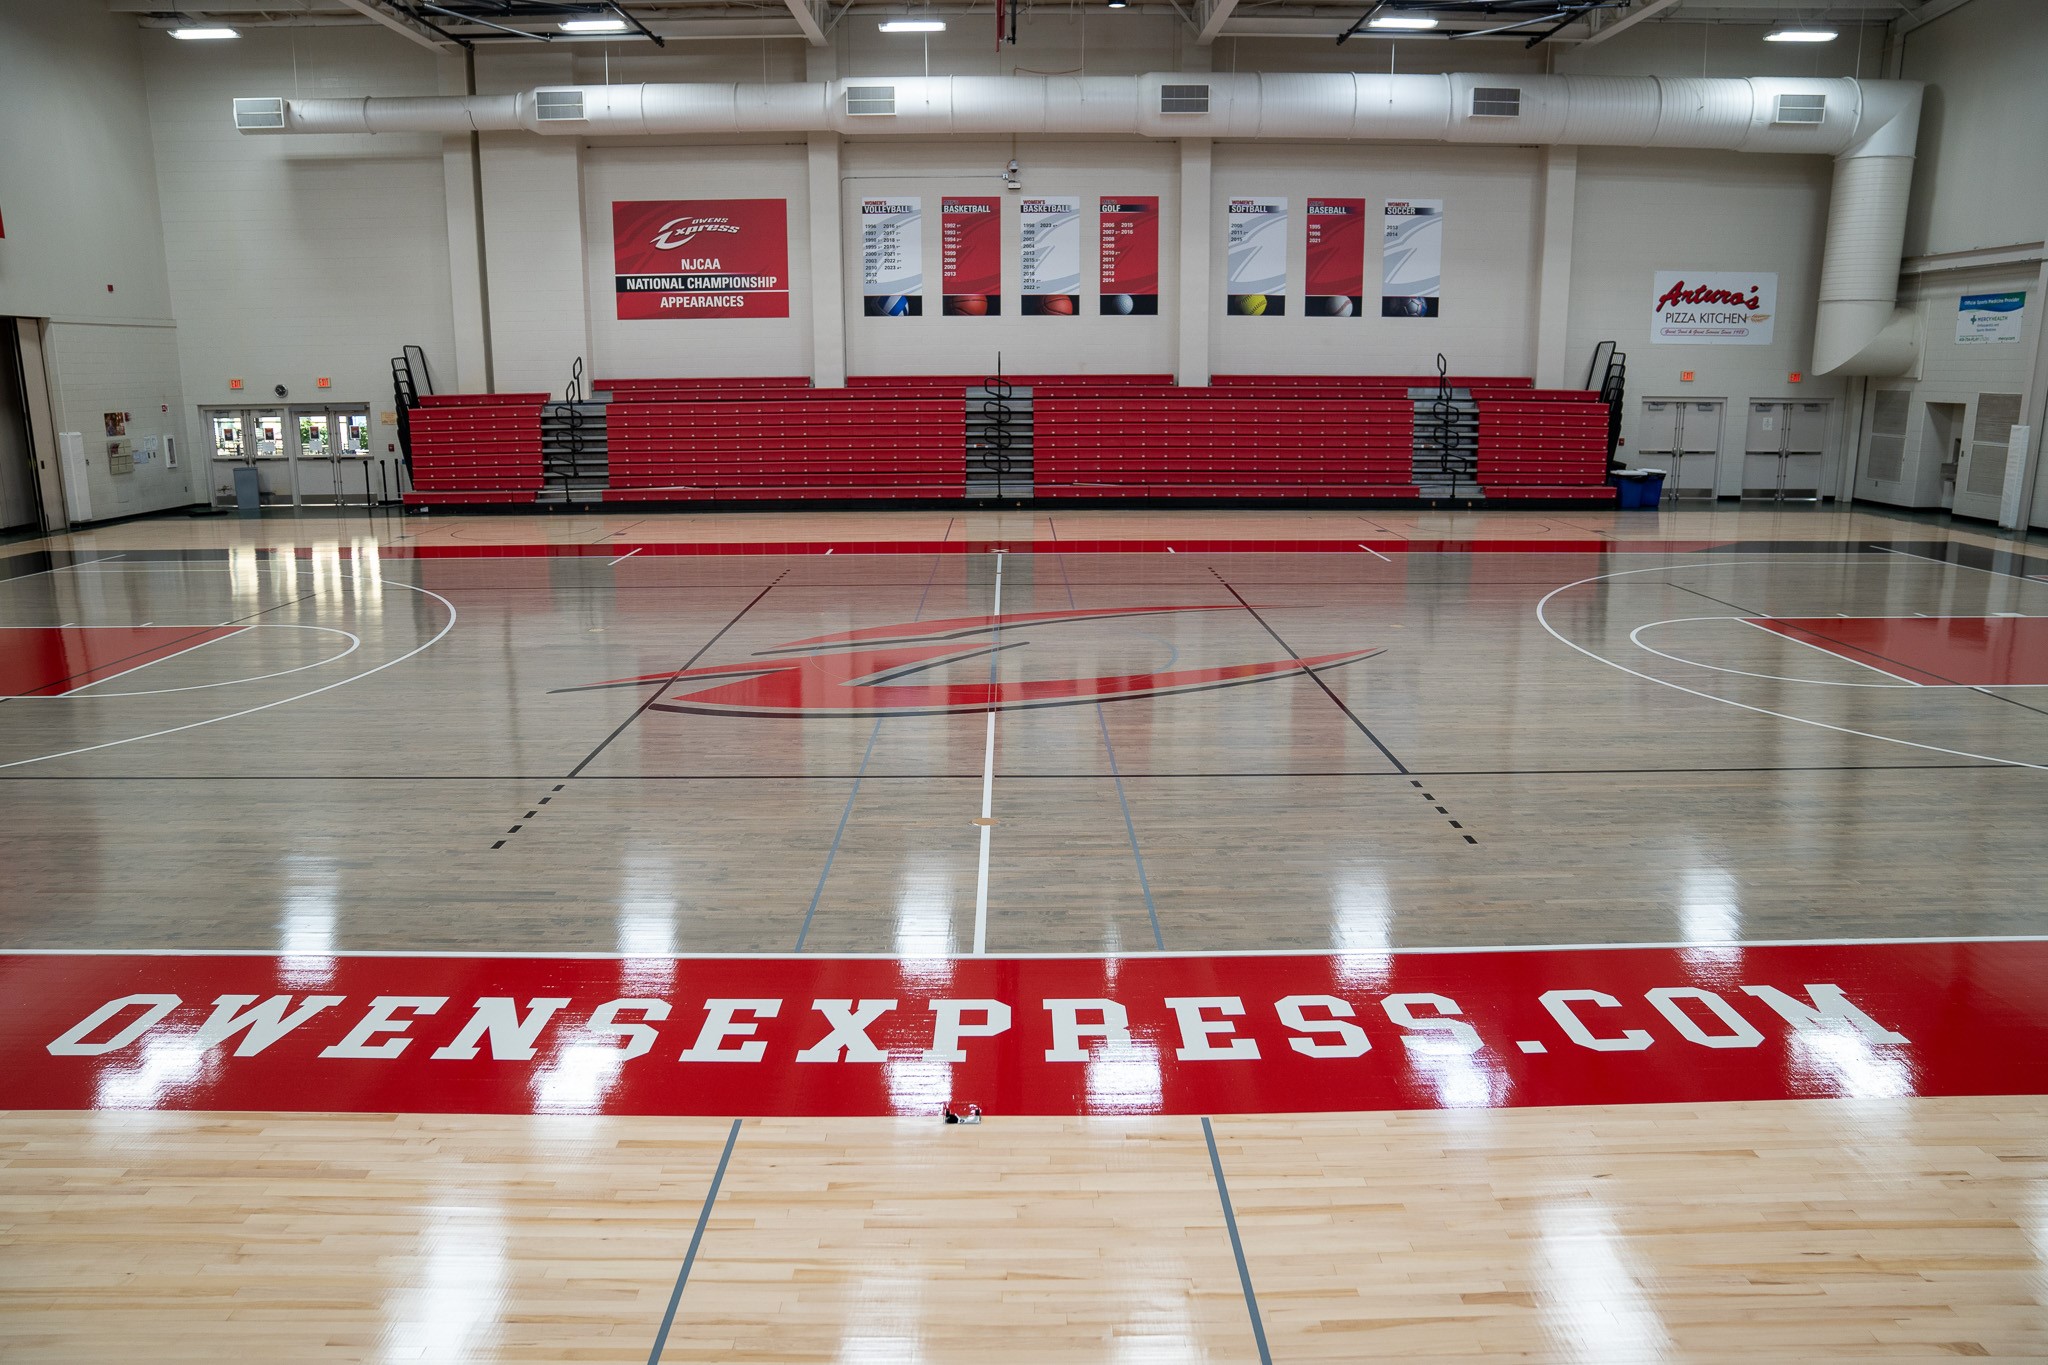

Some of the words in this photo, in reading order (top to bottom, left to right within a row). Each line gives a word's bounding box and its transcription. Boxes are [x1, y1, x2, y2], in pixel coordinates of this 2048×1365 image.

[681, 259, 720, 270] NJCAA
[627, 278, 684, 289] NATIONAL
[687, 277, 777, 288] CHAMPIONSHIP
[661, 296, 744, 308] APPEARANCES
[1656, 281, 1759, 312] Arturo's
[1666, 313, 1696, 323] PIZZA
[1700, 313, 1746, 324] KITCHEN
[46, 984, 1912, 1063] OWENSEXPRESS.COM
